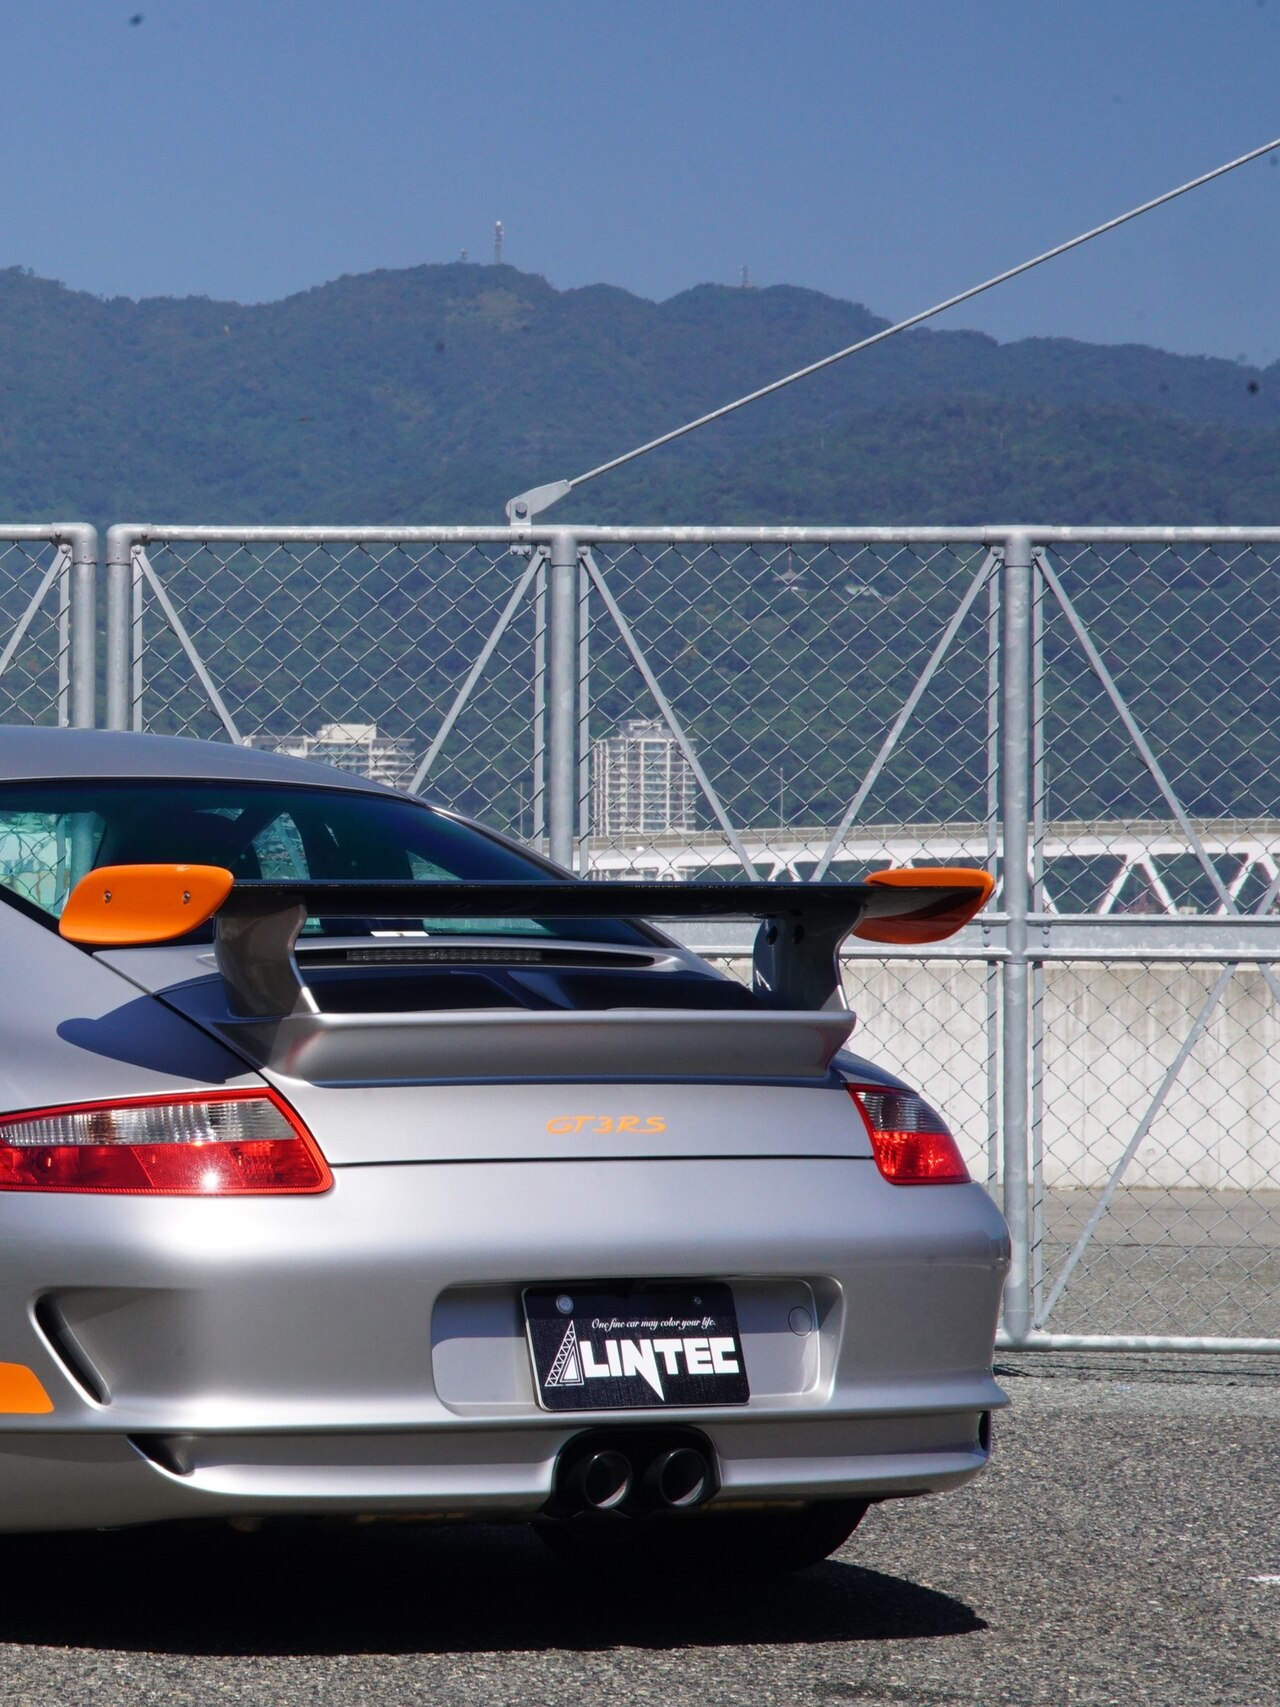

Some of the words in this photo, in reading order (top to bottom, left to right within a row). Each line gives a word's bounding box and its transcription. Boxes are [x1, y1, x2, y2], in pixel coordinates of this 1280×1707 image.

[591, 1318, 609, 1329] One
[605, 1317, 625, 1332] fine
[626, 1320, 639, 1328] car
[640, 1320, 659, 1331] may
[660, 1316, 680, 1328] color
[678, 1319, 701, 1331] your
